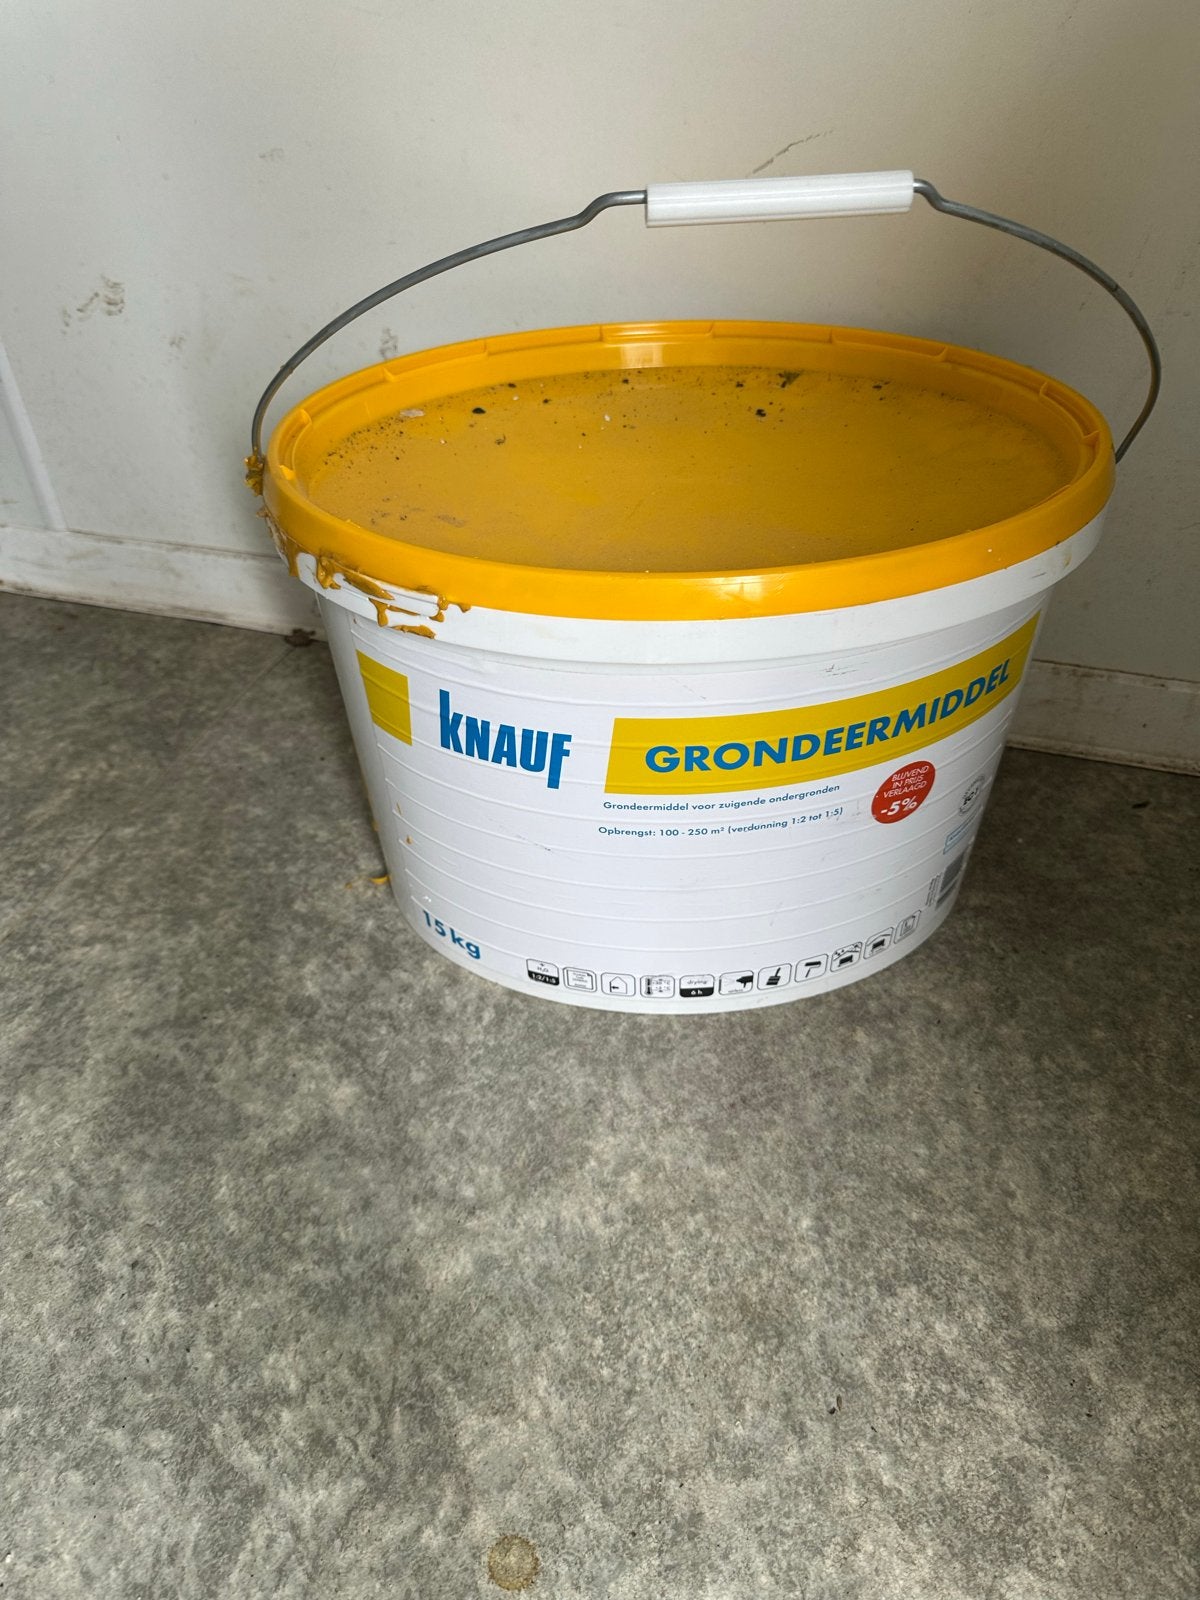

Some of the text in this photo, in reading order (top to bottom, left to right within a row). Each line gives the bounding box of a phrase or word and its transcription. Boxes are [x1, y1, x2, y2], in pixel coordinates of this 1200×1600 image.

[645, 659, 1010, 774] GRONDEERMIDDEL
[439, 689, 572, 789] KNAUF
[603, 784, 840, 811] Grondeermiddel voor zuigende ondergronden
[883, 780, 927, 798] VERLAAGD
[892, 780, 903, 789] IN
[880, 795, 917, 816] -5%
[598, 826, 656, 838] Opbrengst:
[659, 829, 679, 837] 100
[688, 828, 708, 836] 250
[728, 819, 788, 835] (verdunning
[791, 815, 807, 824] 1:2
[809, 812, 822, 821] tot
[825, 806, 843, 819] 1:5)
[423, 909, 481, 960] 15 kg
